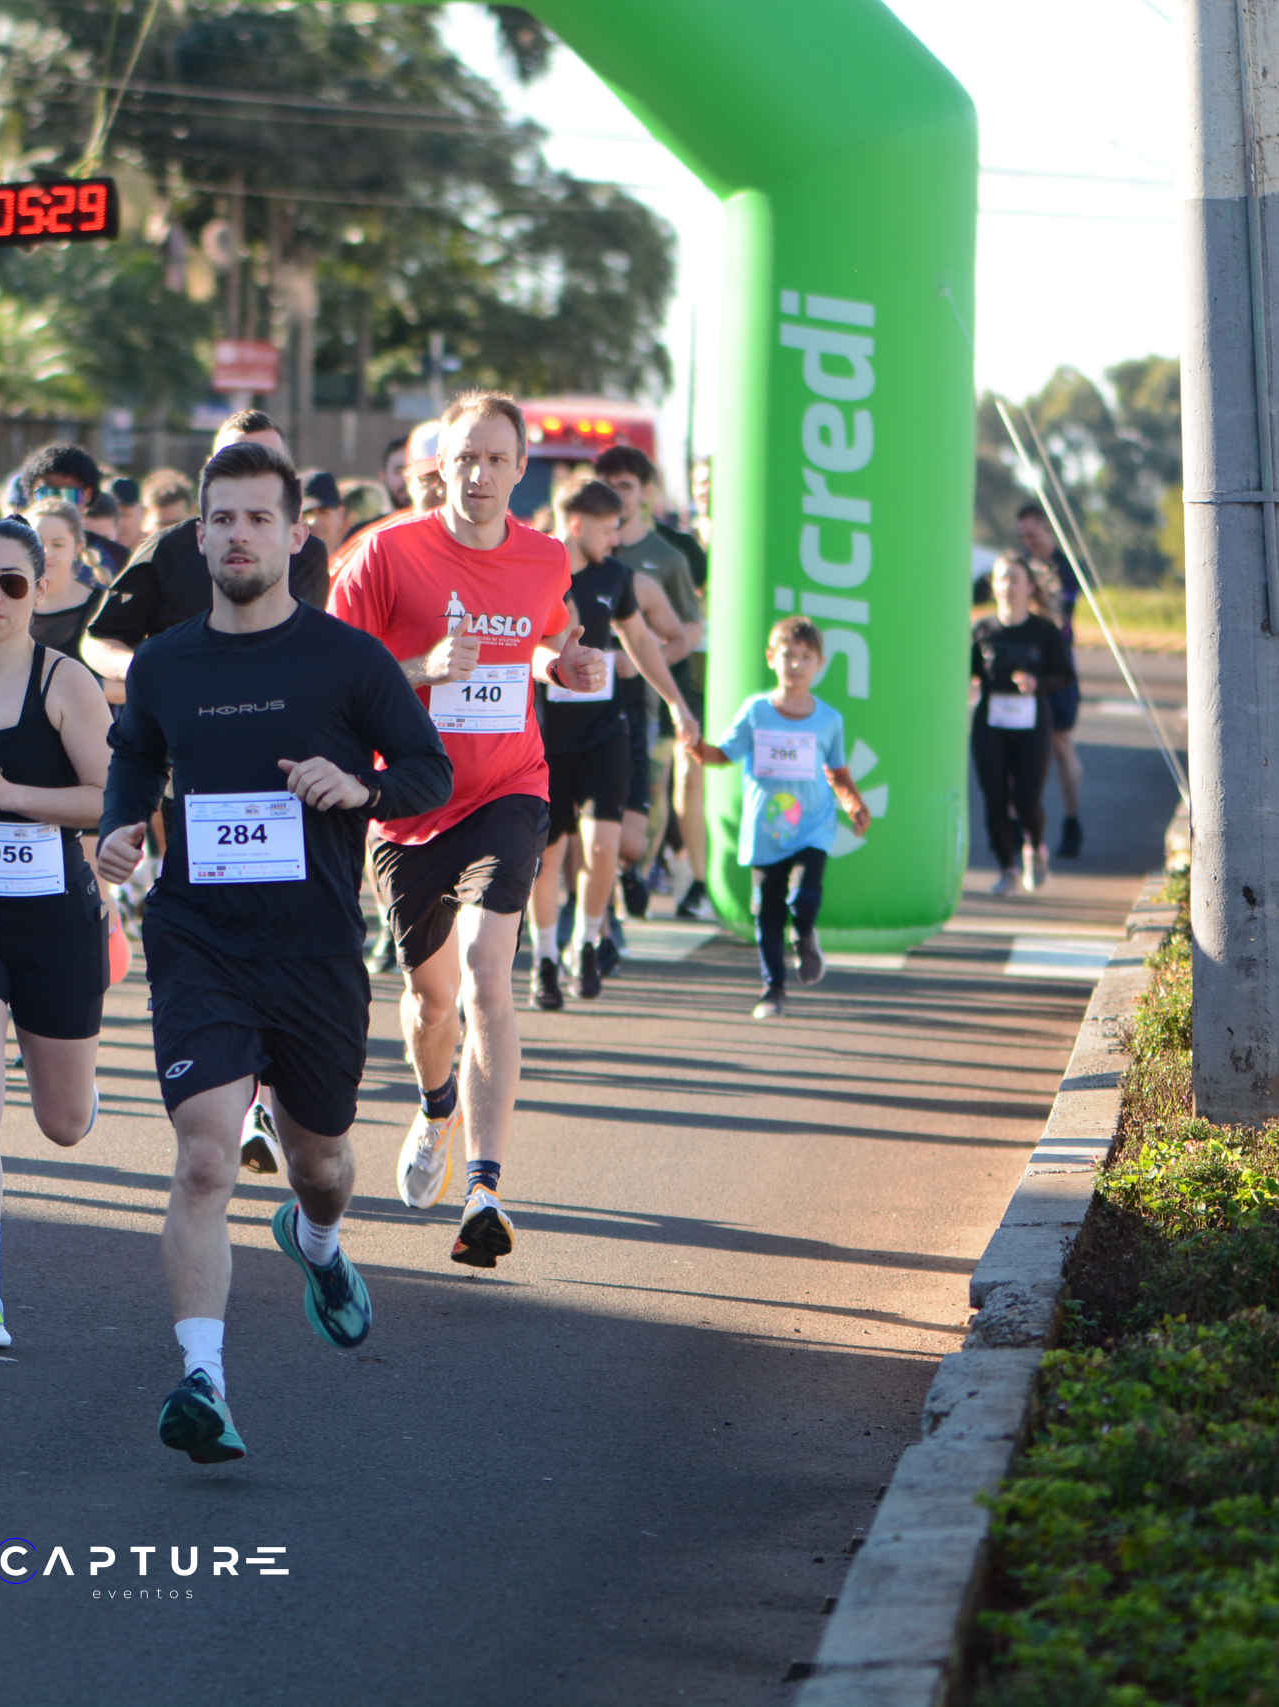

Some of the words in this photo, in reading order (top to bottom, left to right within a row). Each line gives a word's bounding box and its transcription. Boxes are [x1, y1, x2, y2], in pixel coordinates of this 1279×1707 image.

[461, 685, 502, 703] 140
[198, 700, 285, 716] HORUS
[770, 748, 797, 761] 296
[217, 823, 268, 846] 284
